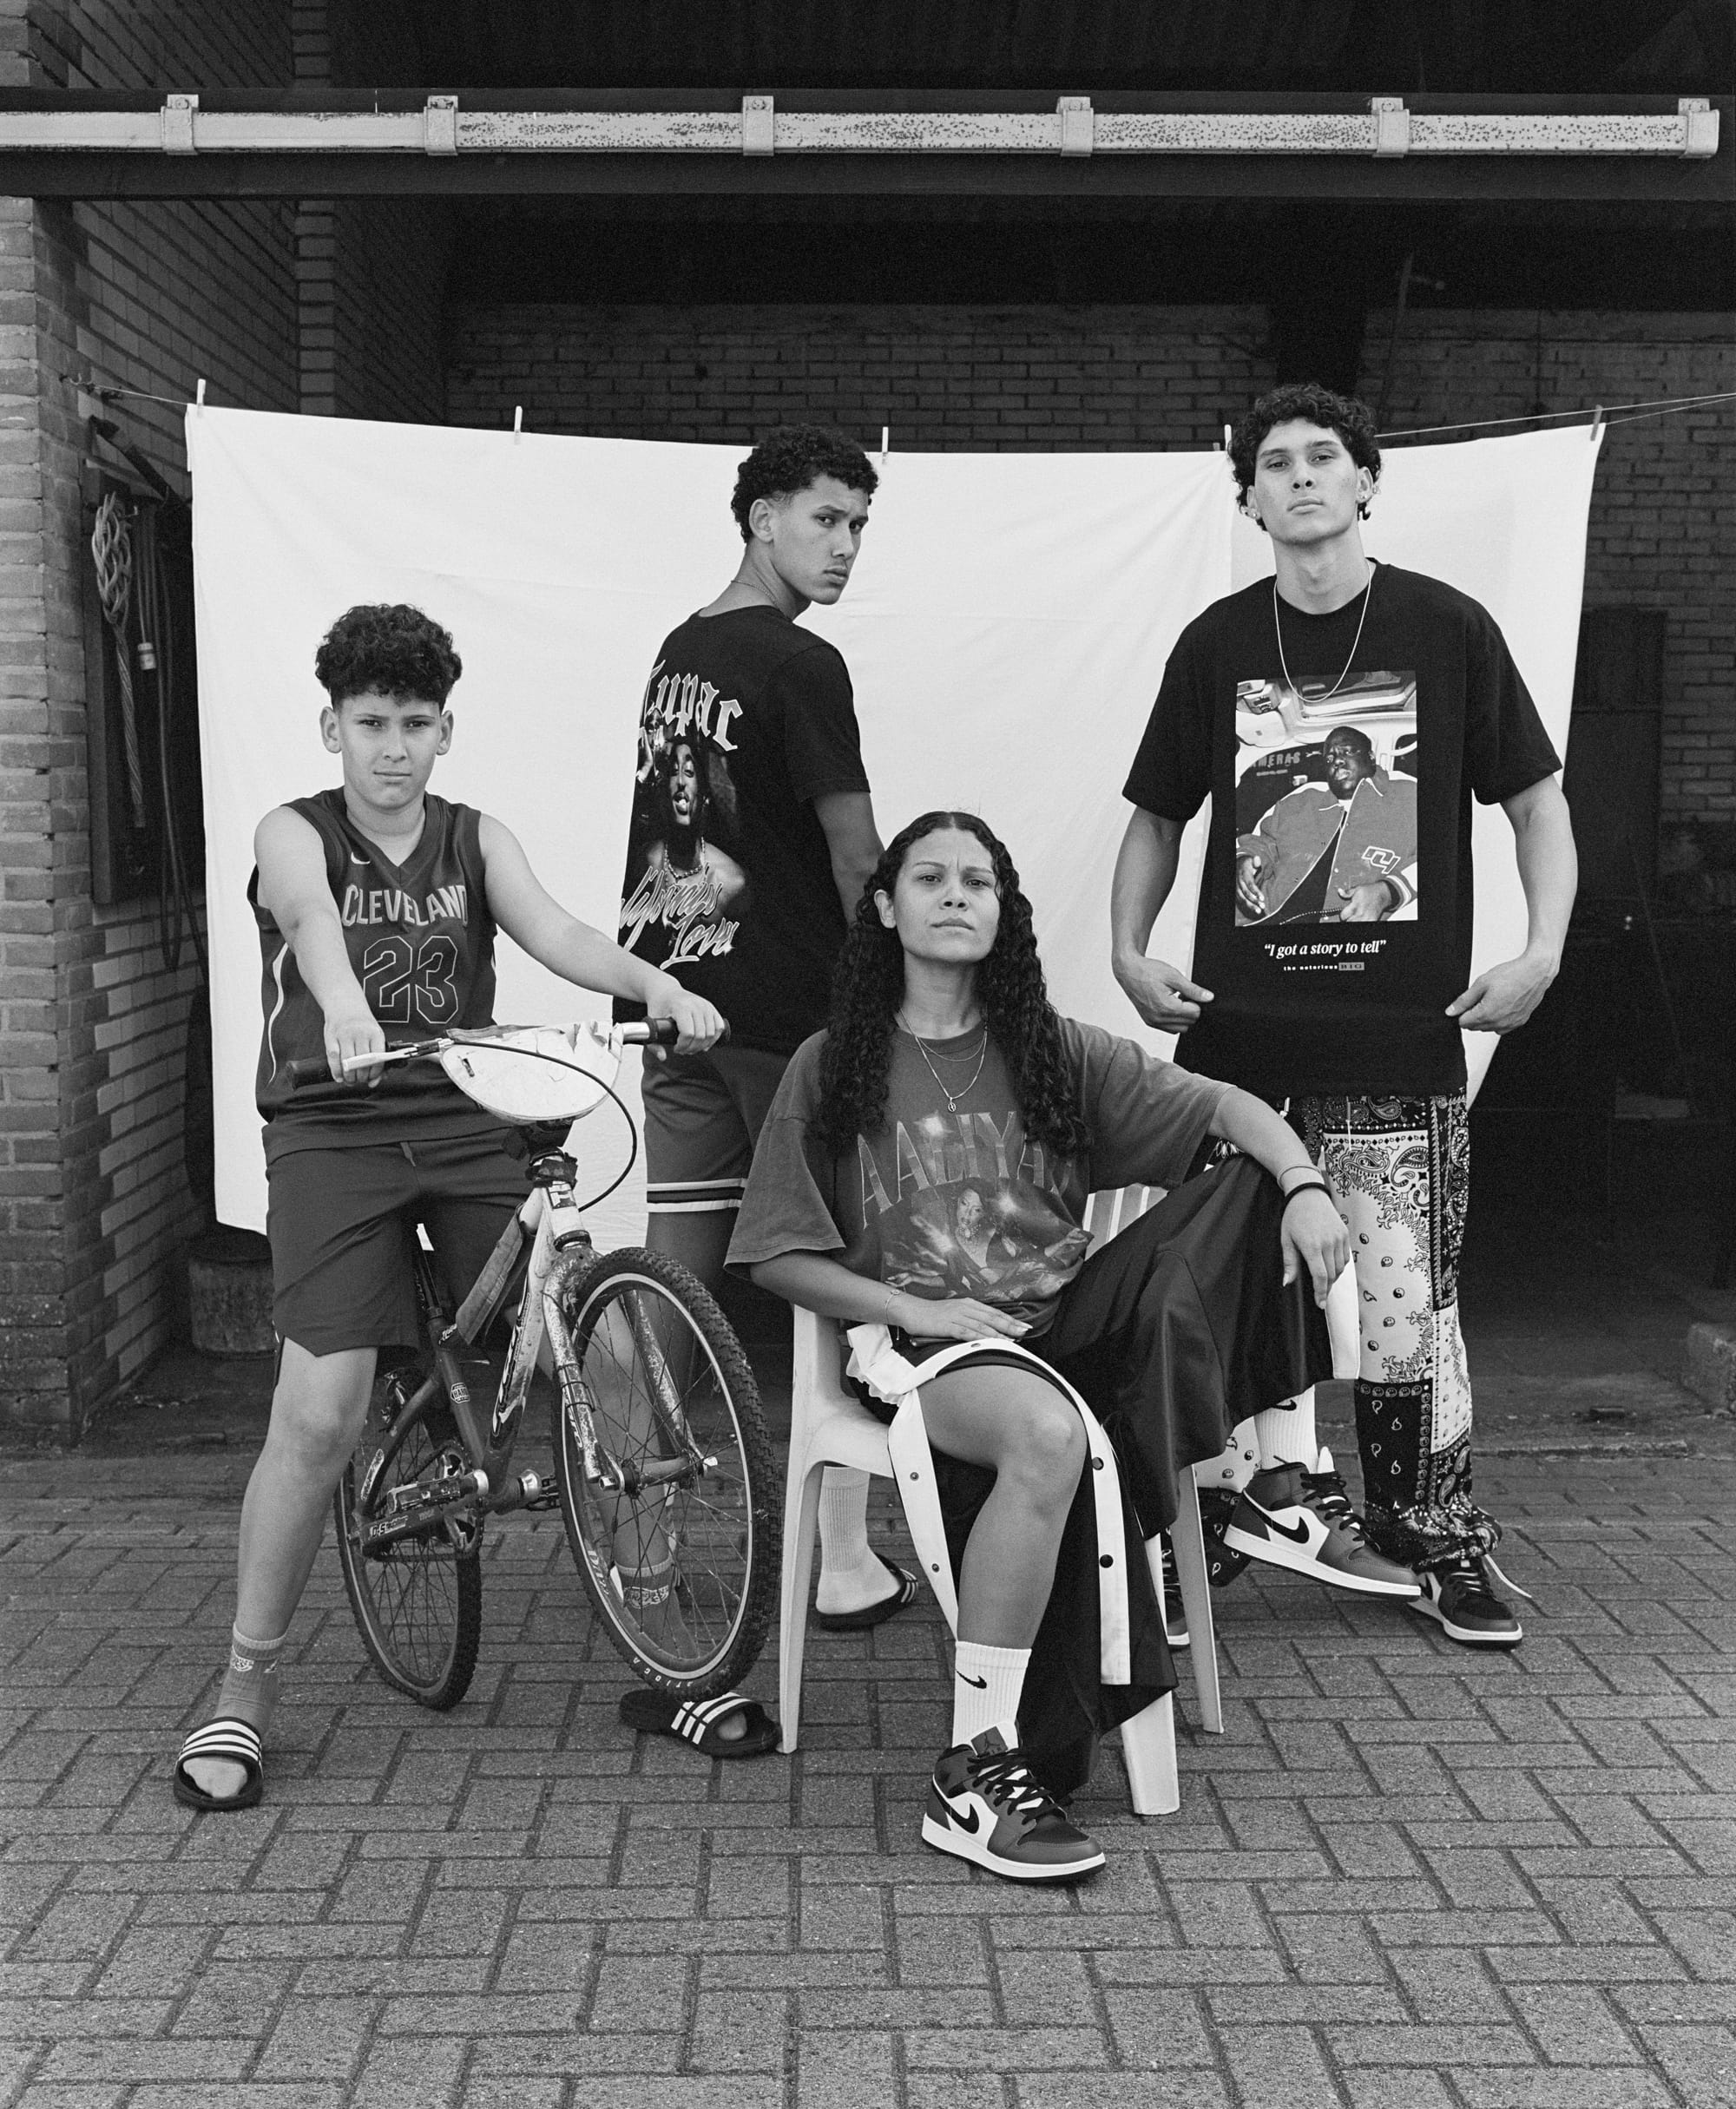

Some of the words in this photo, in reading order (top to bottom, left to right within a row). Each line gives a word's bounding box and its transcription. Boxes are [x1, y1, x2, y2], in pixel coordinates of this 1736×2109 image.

[342, 884, 469, 928] CLEVELAND
[1276, 943, 1297, 959] got
[1299, 944, 1308, 955] a
[1310, 943, 1343, 957] story
[1345, 942, 1358, 954] to
[363, 936, 459, 1024] 23
